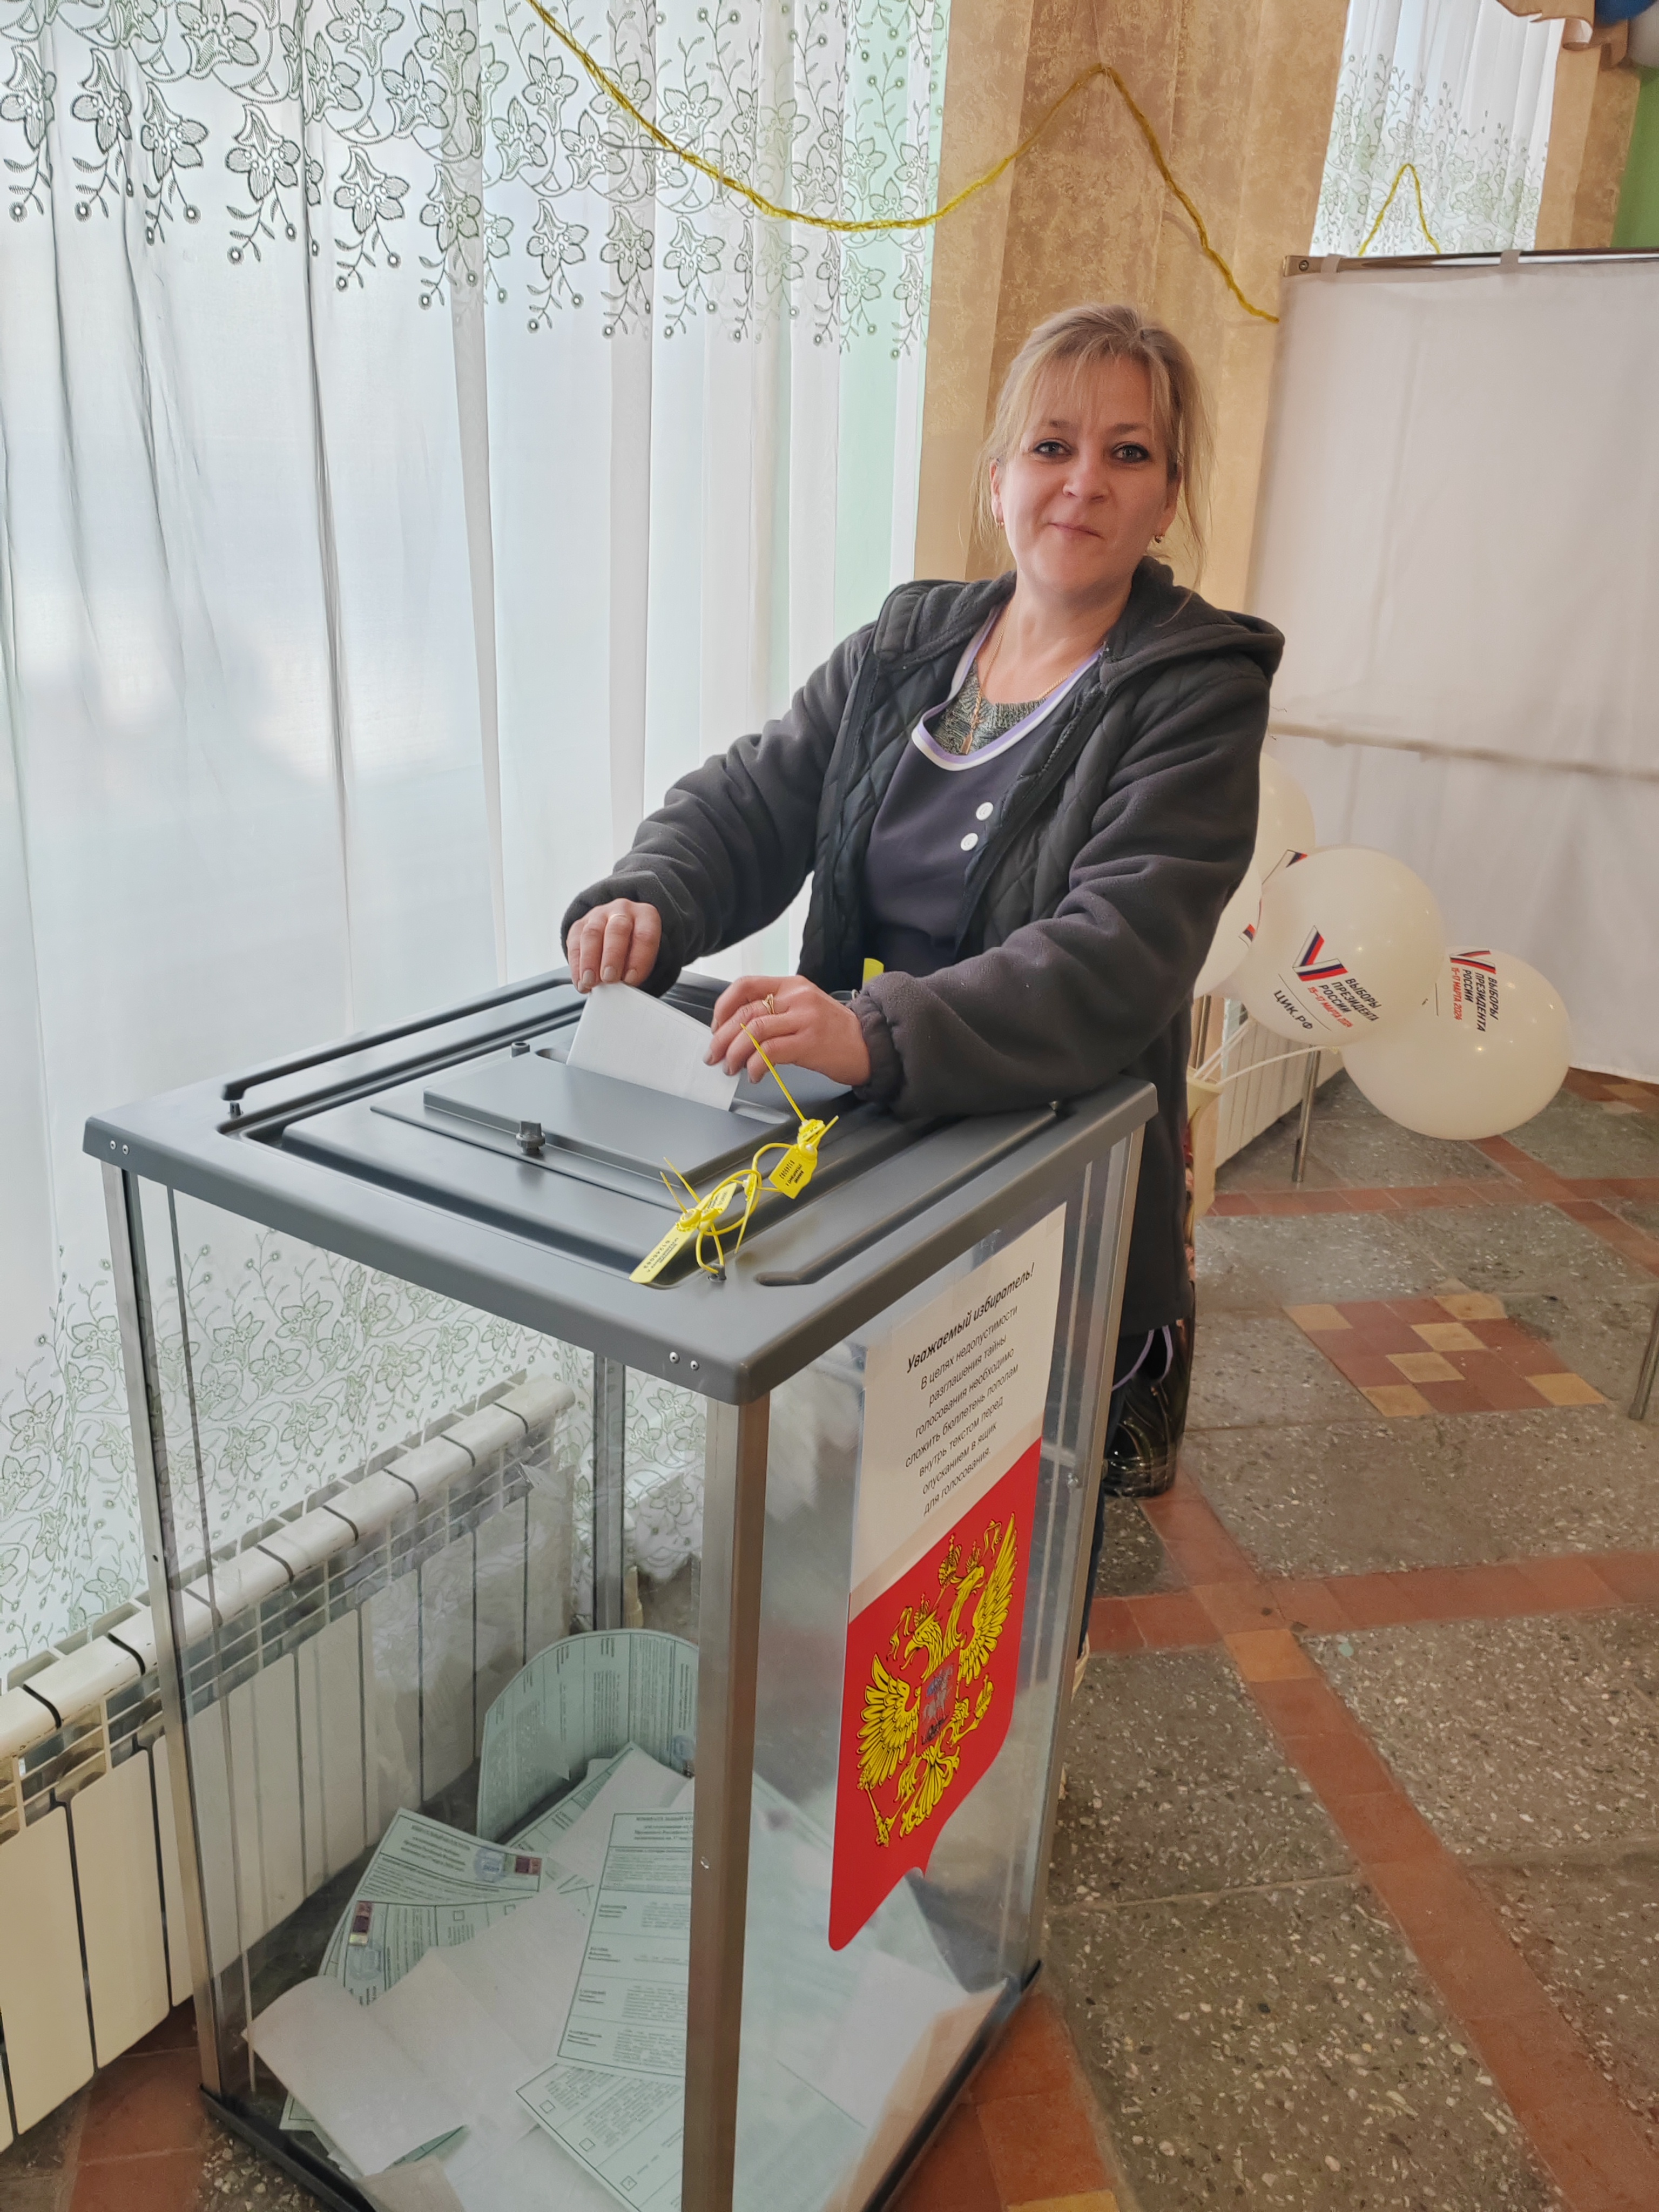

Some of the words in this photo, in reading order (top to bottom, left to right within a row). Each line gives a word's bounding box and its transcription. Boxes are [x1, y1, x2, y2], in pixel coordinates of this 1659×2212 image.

[1273, 990, 1313, 1029] ЦИК.РФ
[1318, 984, 1352, 1013] РОССИИ
[1331, 981, 1379, 1021] ПРЕЗИДЕНТА
[1345, 978, 1381, 1009] ВЫБОРЫ
[1462, 968, 1474, 1003] РОССИИ
[1475, 972, 1486, 1033] ПРЕЗИДЕНТА
[1488, 976, 1499, 1020] ВЫБОРЫ
[907, 1310, 972, 1373] Уважаемый
[973, 1262, 1035, 1321] избиратель!
[921, 1375, 927, 1390] В
[929, 1356, 955, 1383] целях
[956, 1305, 1018, 1362] недопустимости
[915, 1388, 967, 1438] голосования
[969, 1348, 1014, 1393] необходимо
[929, 1355, 982, 1408] разглашения
[983, 1334, 1007, 1359] тайны
[906, 1433, 940, 1468] сложить
[942, 1394, 986, 1435] бюллетень
[987, 1364, 1019, 1397] пополам
[919, 1448, 947, 1477] внутрь
[949, 1417, 979, 1450] текстом
[981, 1396, 1003, 1422] перед
[922, 1446, 969, 1494] опусканием
[971, 1441, 976, 1450] в
[978, 1421, 997, 1445] ящик
[923, 1494, 939, 1517] для
[941, 1447, 991, 1498] голосования.
